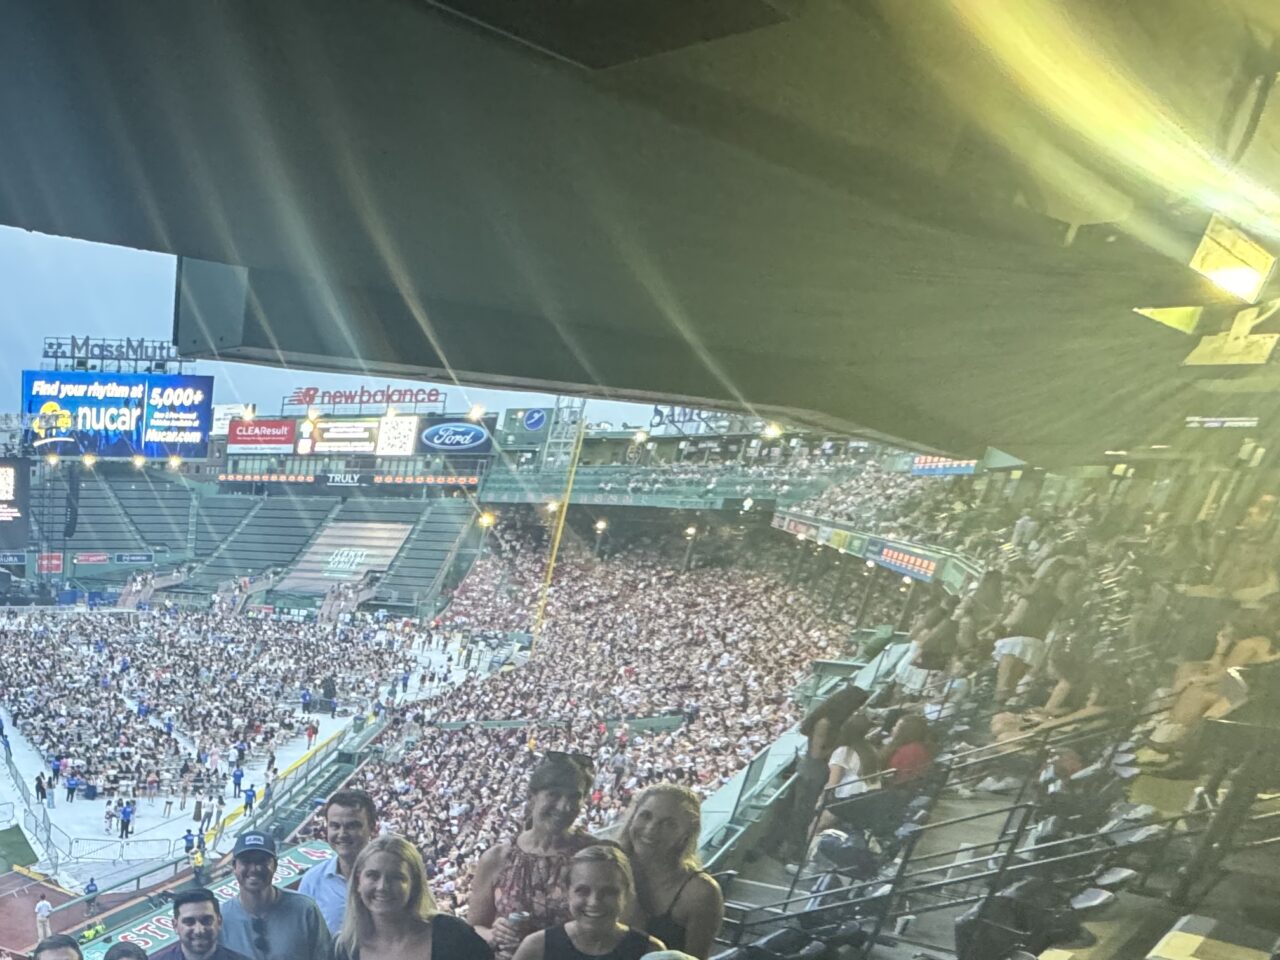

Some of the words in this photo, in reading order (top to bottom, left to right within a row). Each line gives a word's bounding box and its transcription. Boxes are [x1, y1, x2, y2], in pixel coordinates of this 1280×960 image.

[32, 381, 59, 396] Find
[59, 384, 88, 399] your
[87, 382, 128, 400] rhythm
[129, 384, 144, 398] at
[150, 387, 204, 409] 5,000+
[321, 390, 358, 405] new
[360, 384, 440, 404] balance
[77, 405, 141, 431] nucar
[145, 429, 202, 443] Nucar.com
[236, 426, 288, 436] CLEAResult
[433, 427, 472, 445] Ford
[327, 473, 360, 483] TRULY
